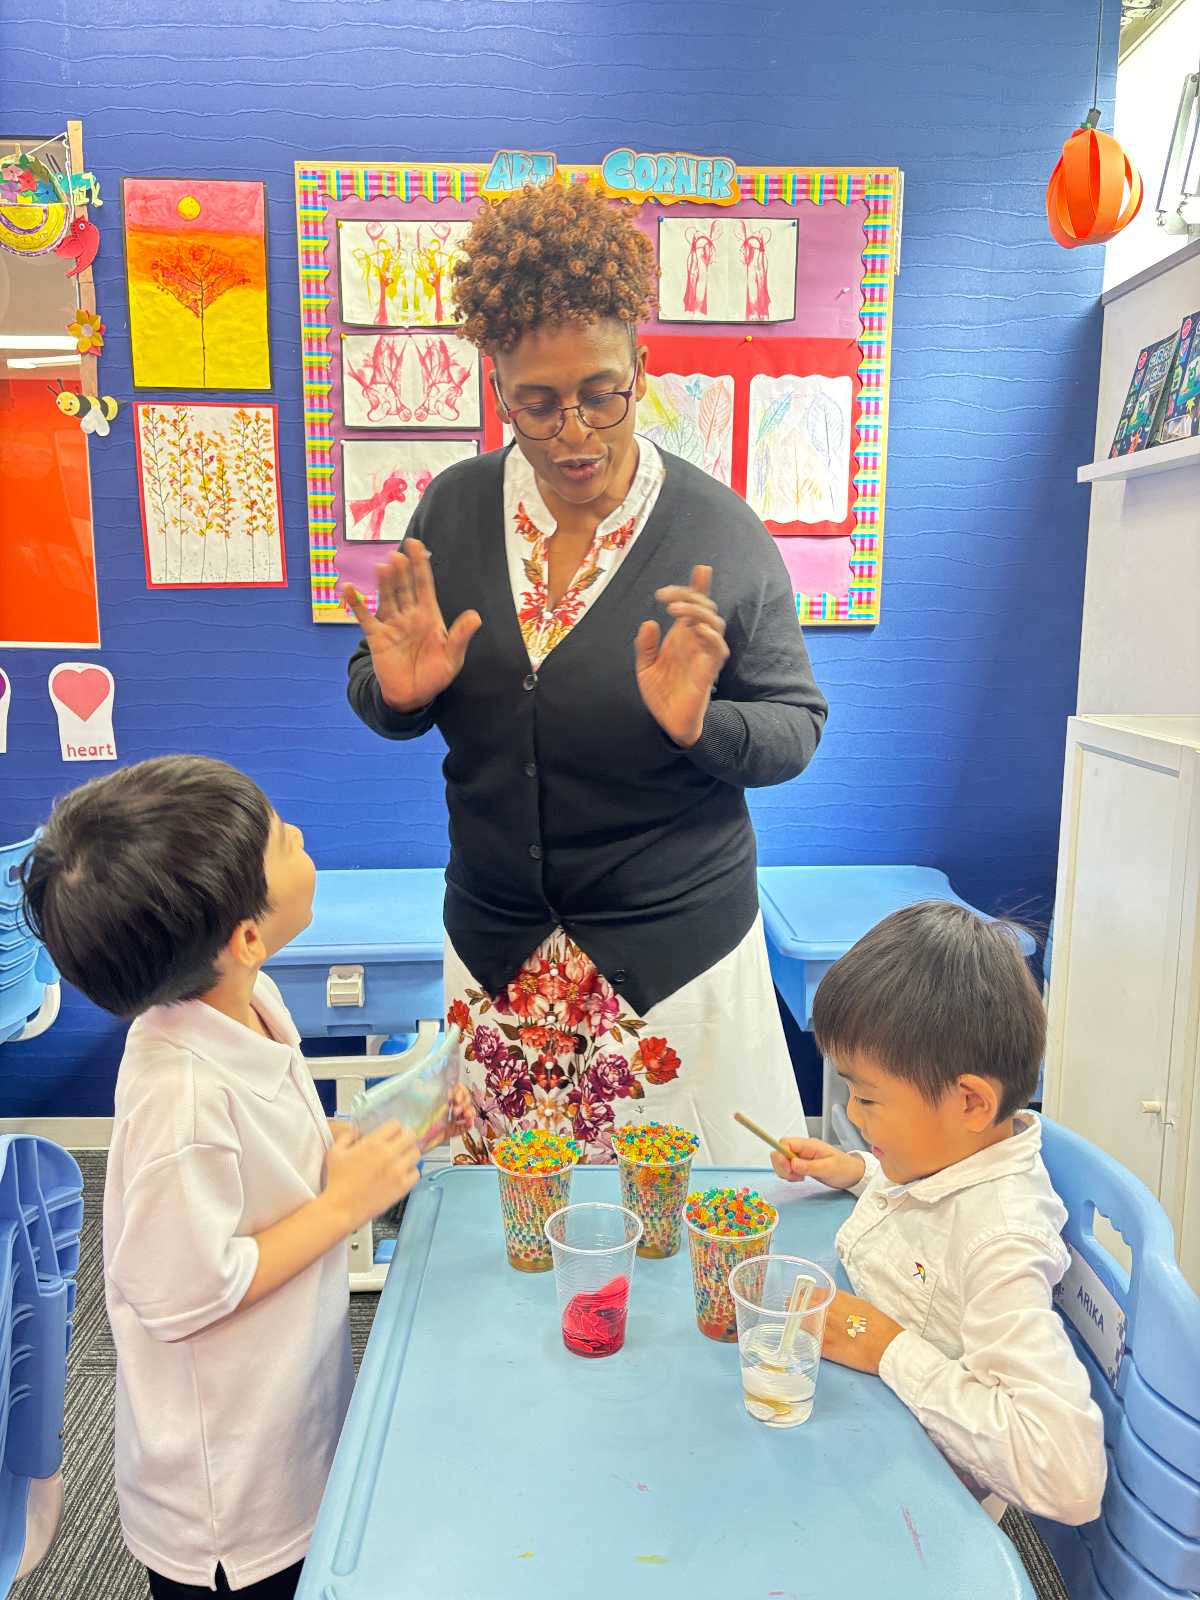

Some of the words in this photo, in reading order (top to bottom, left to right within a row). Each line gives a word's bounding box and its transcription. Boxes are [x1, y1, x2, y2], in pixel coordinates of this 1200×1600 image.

[603, 151, 736, 199] CORNER
[66, 744, 114, 758] heart
[1076, 1284, 1105, 1334] ARIKA
